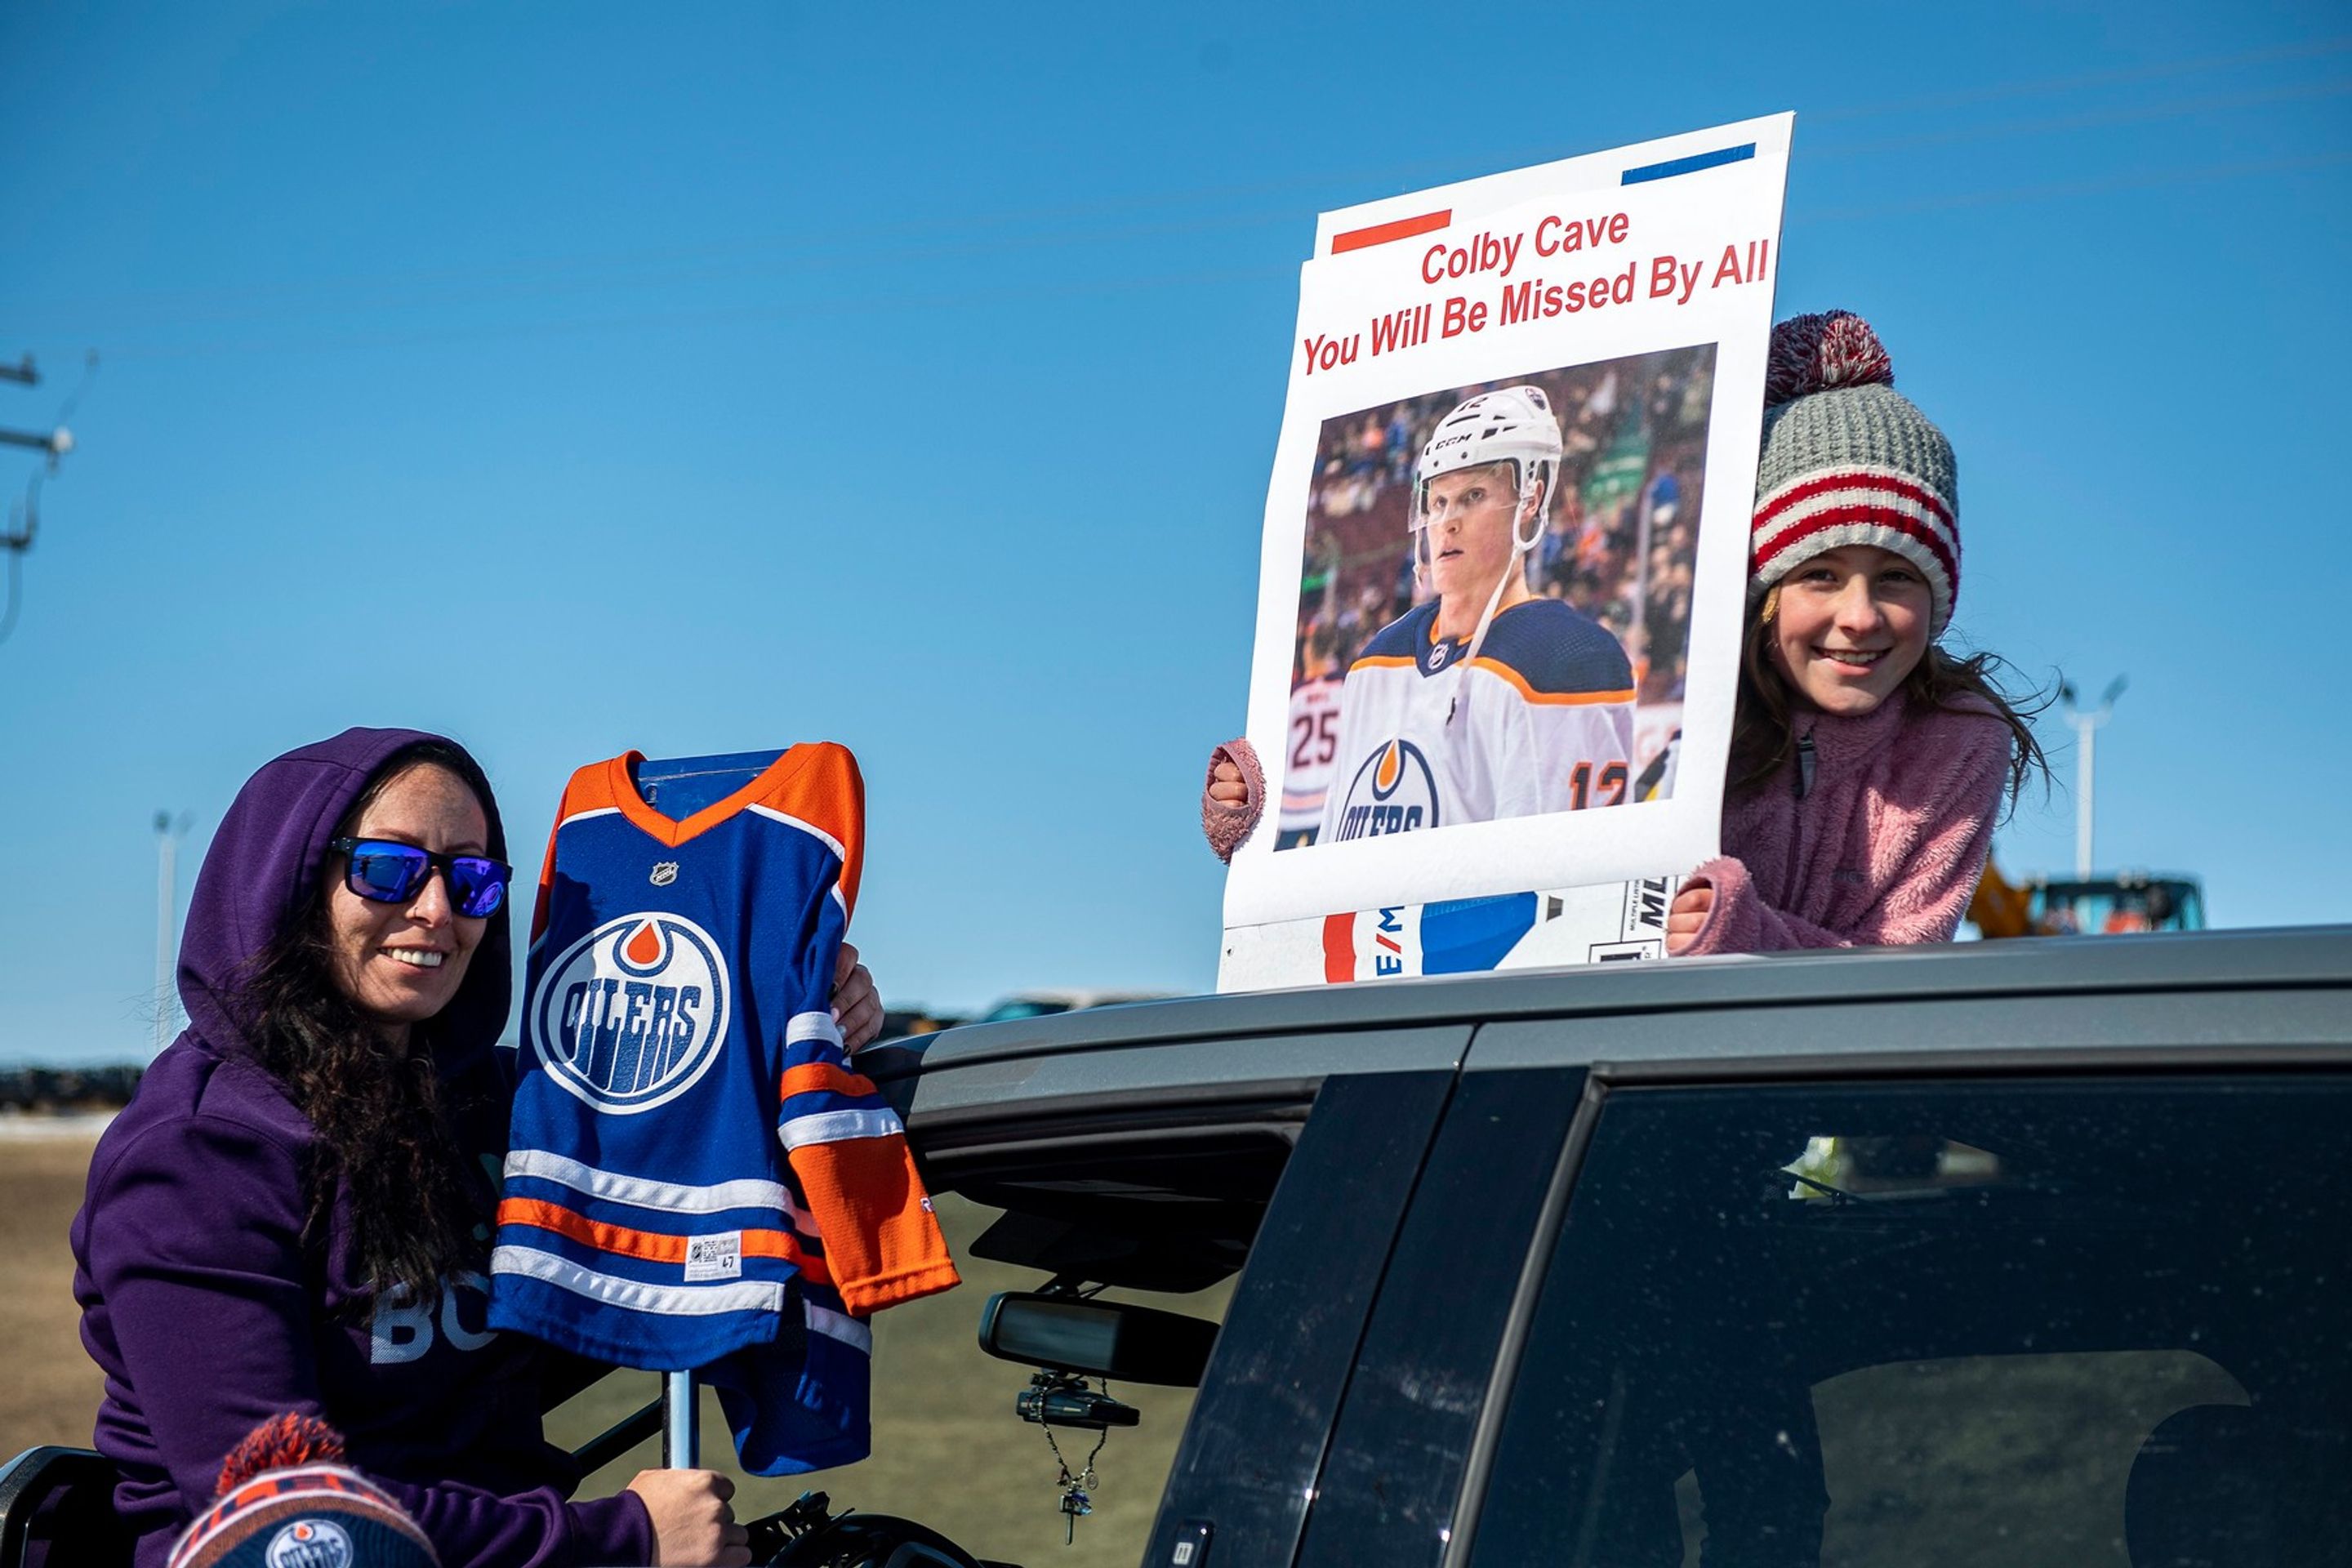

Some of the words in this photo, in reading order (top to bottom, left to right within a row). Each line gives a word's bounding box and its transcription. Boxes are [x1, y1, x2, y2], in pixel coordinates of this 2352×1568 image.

[1422, 231, 1524, 284] Colby
[1535, 212, 1629, 257] Cave
[1304, 333, 1360, 376] You
[1372, 303, 1432, 357] Will
[1441, 296, 1488, 339] Be
[1499, 261, 1637, 326] Missed
[1649, 256, 1704, 305] By
[1711, 239, 1769, 288] All
[1435, 433, 1472, 450] CCM
[1292, 710, 1339, 768] 25
[559, 978, 702, 1094] OILERS
